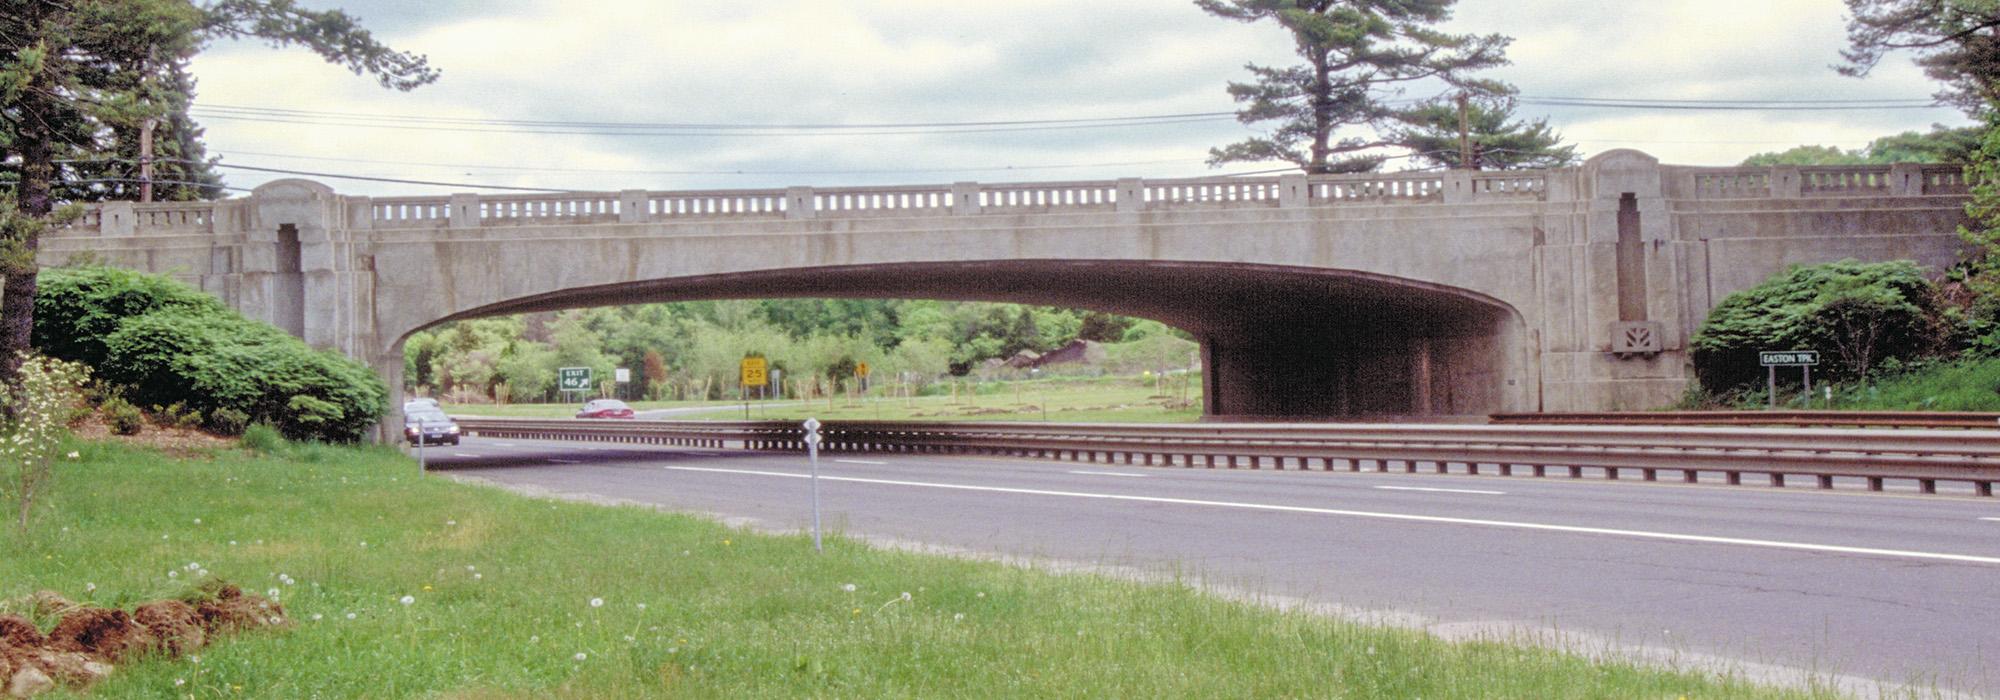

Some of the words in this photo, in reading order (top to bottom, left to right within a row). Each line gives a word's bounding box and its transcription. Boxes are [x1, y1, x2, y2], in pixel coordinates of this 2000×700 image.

[1763, 354, 1795, 363] EASTON
[747, 369, 762, 378] 25
[564, 377, 578, 386] 46
